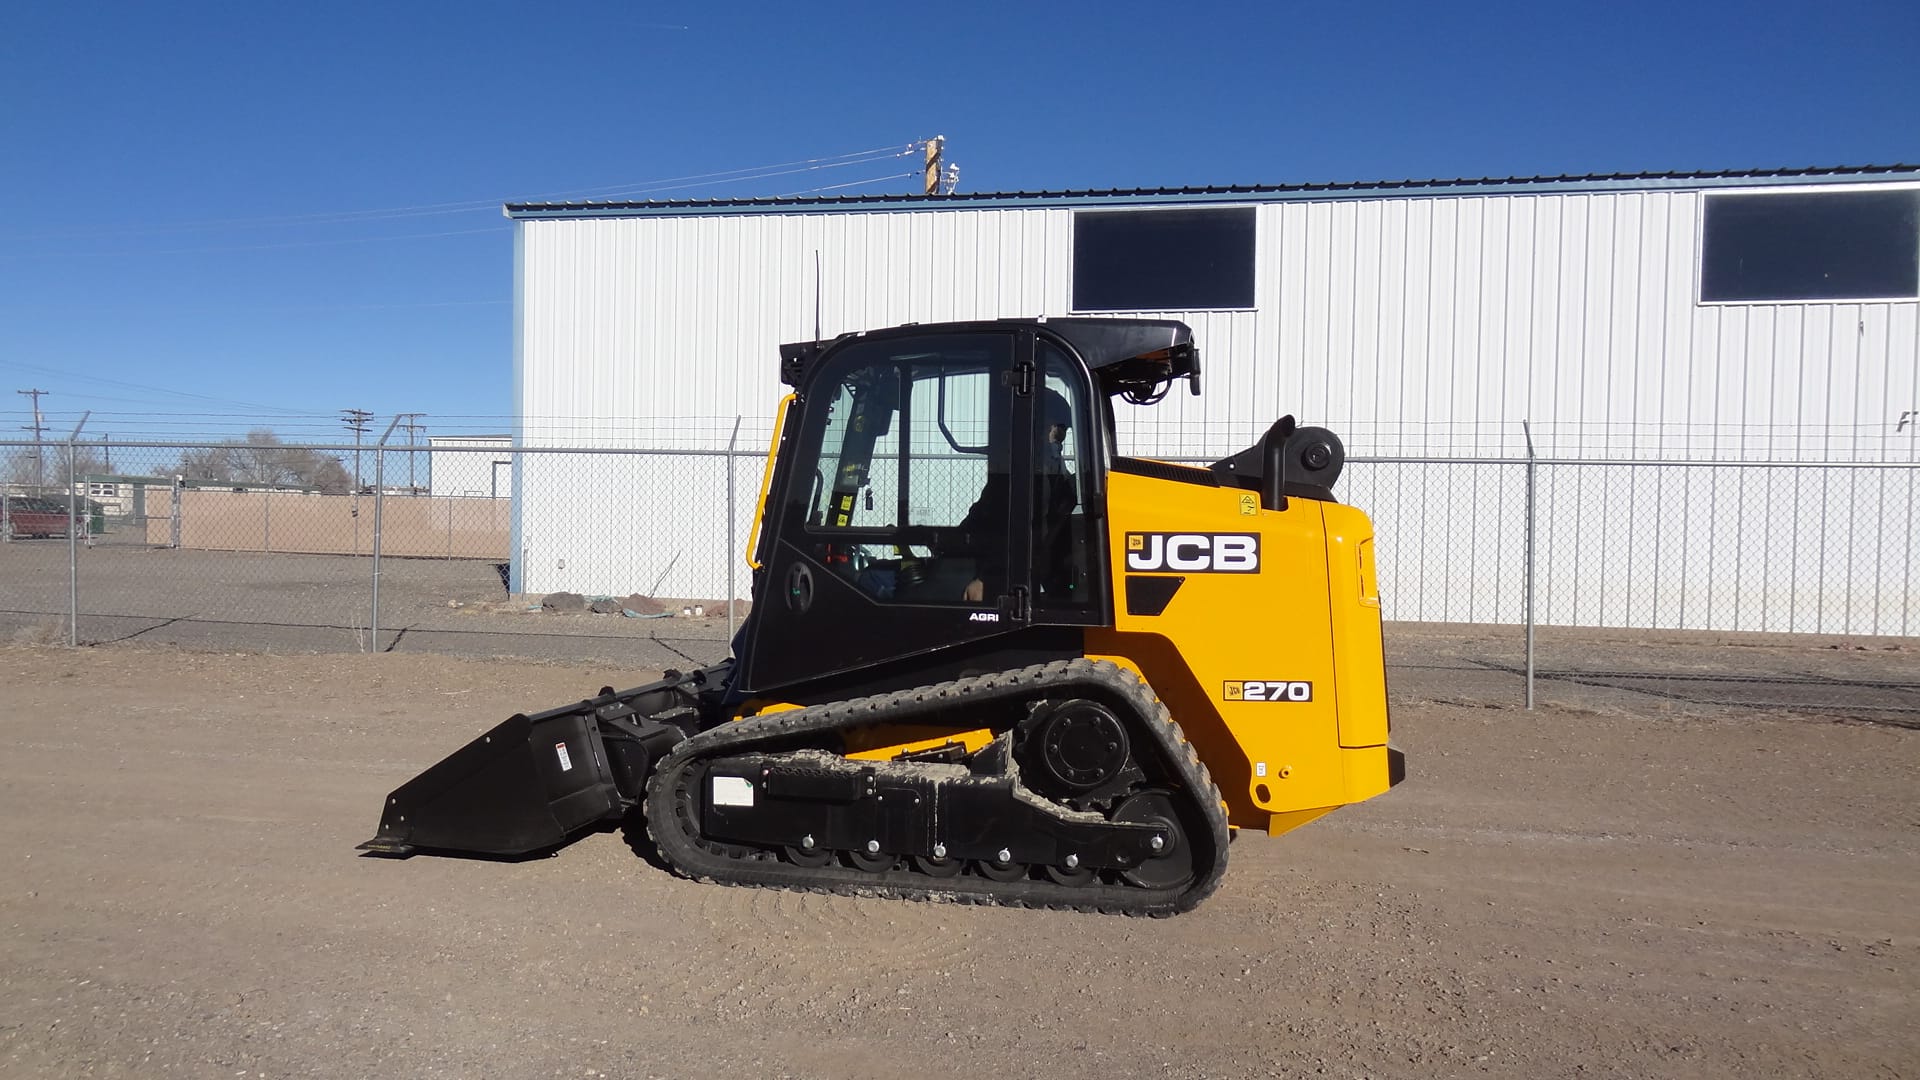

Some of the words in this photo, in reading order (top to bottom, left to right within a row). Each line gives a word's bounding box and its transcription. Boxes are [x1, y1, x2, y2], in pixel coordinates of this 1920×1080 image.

[1128, 535, 1257, 570] JCB
[969, 612, 999, 622] AGRI
[1244, 682, 1310, 700] 270
